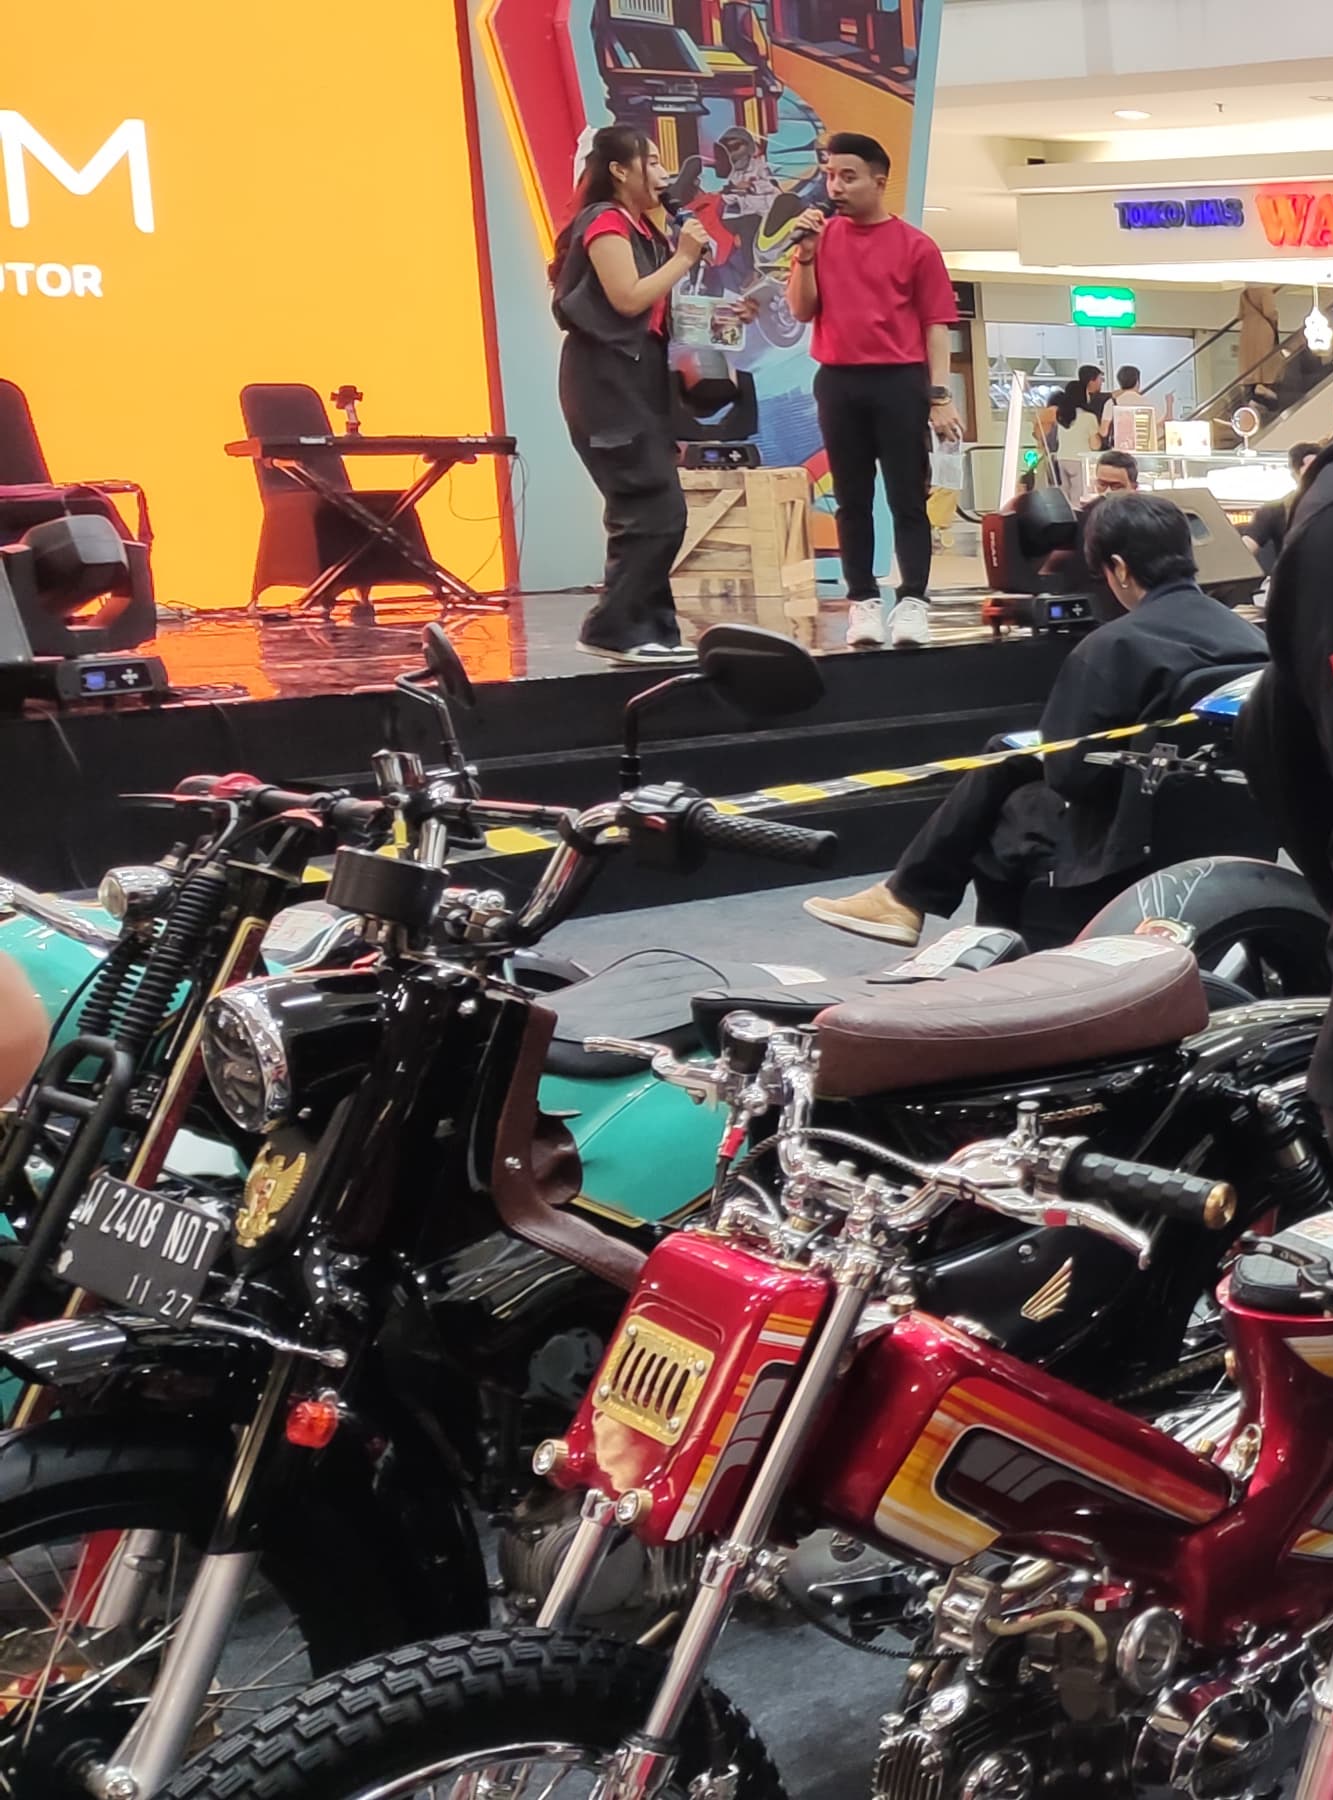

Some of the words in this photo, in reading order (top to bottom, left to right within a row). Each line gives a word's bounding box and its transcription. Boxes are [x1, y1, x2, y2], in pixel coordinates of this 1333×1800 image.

[1114, 201, 1184, 230] TOKO
[78, 1177, 110, 1226] W
[99, 1187, 165, 1249] 2408
[160, 1210, 220, 1271] NDT
